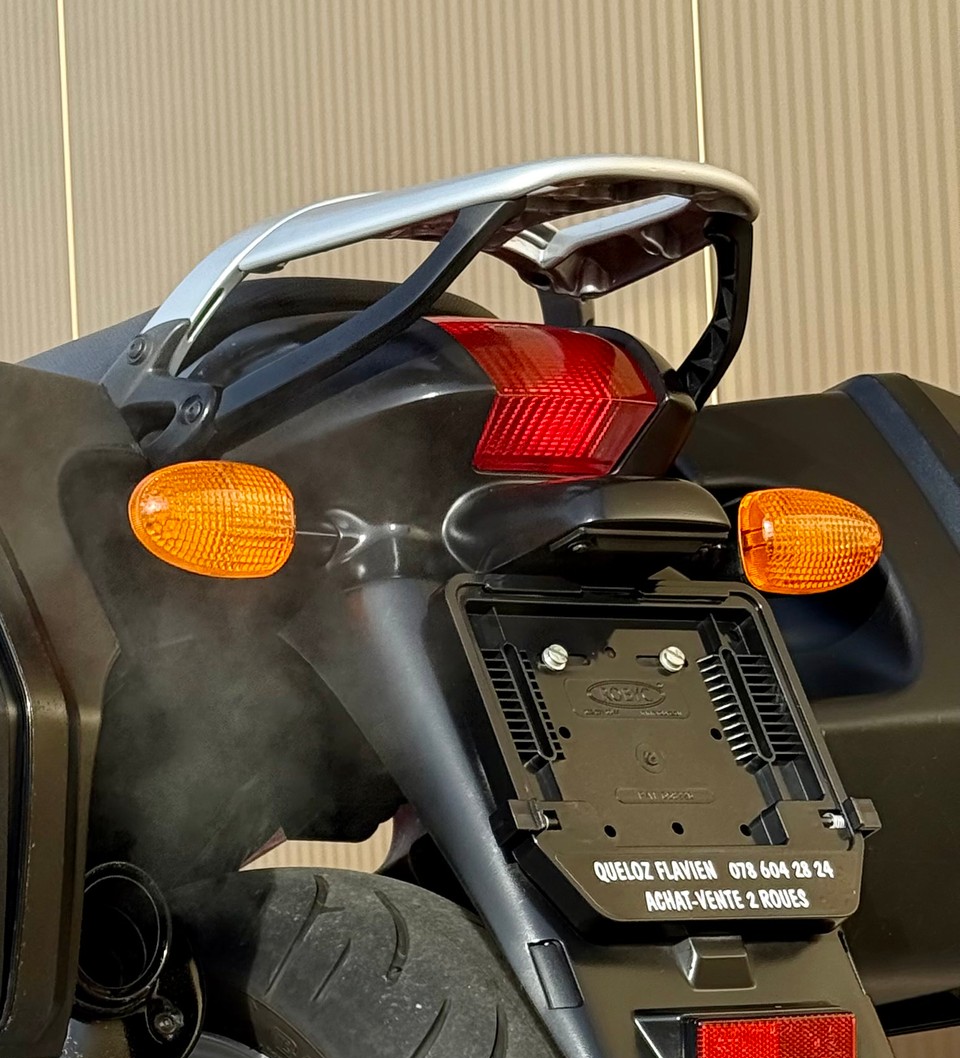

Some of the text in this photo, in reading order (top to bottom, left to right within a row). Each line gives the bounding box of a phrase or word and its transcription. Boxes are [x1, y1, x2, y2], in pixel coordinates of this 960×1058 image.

[594, 859, 835, 883] QUELOZ FLAVIEN 078 604 28 24
[645, 888, 810, 912] ACHAT-VENTE 2 ROUES
